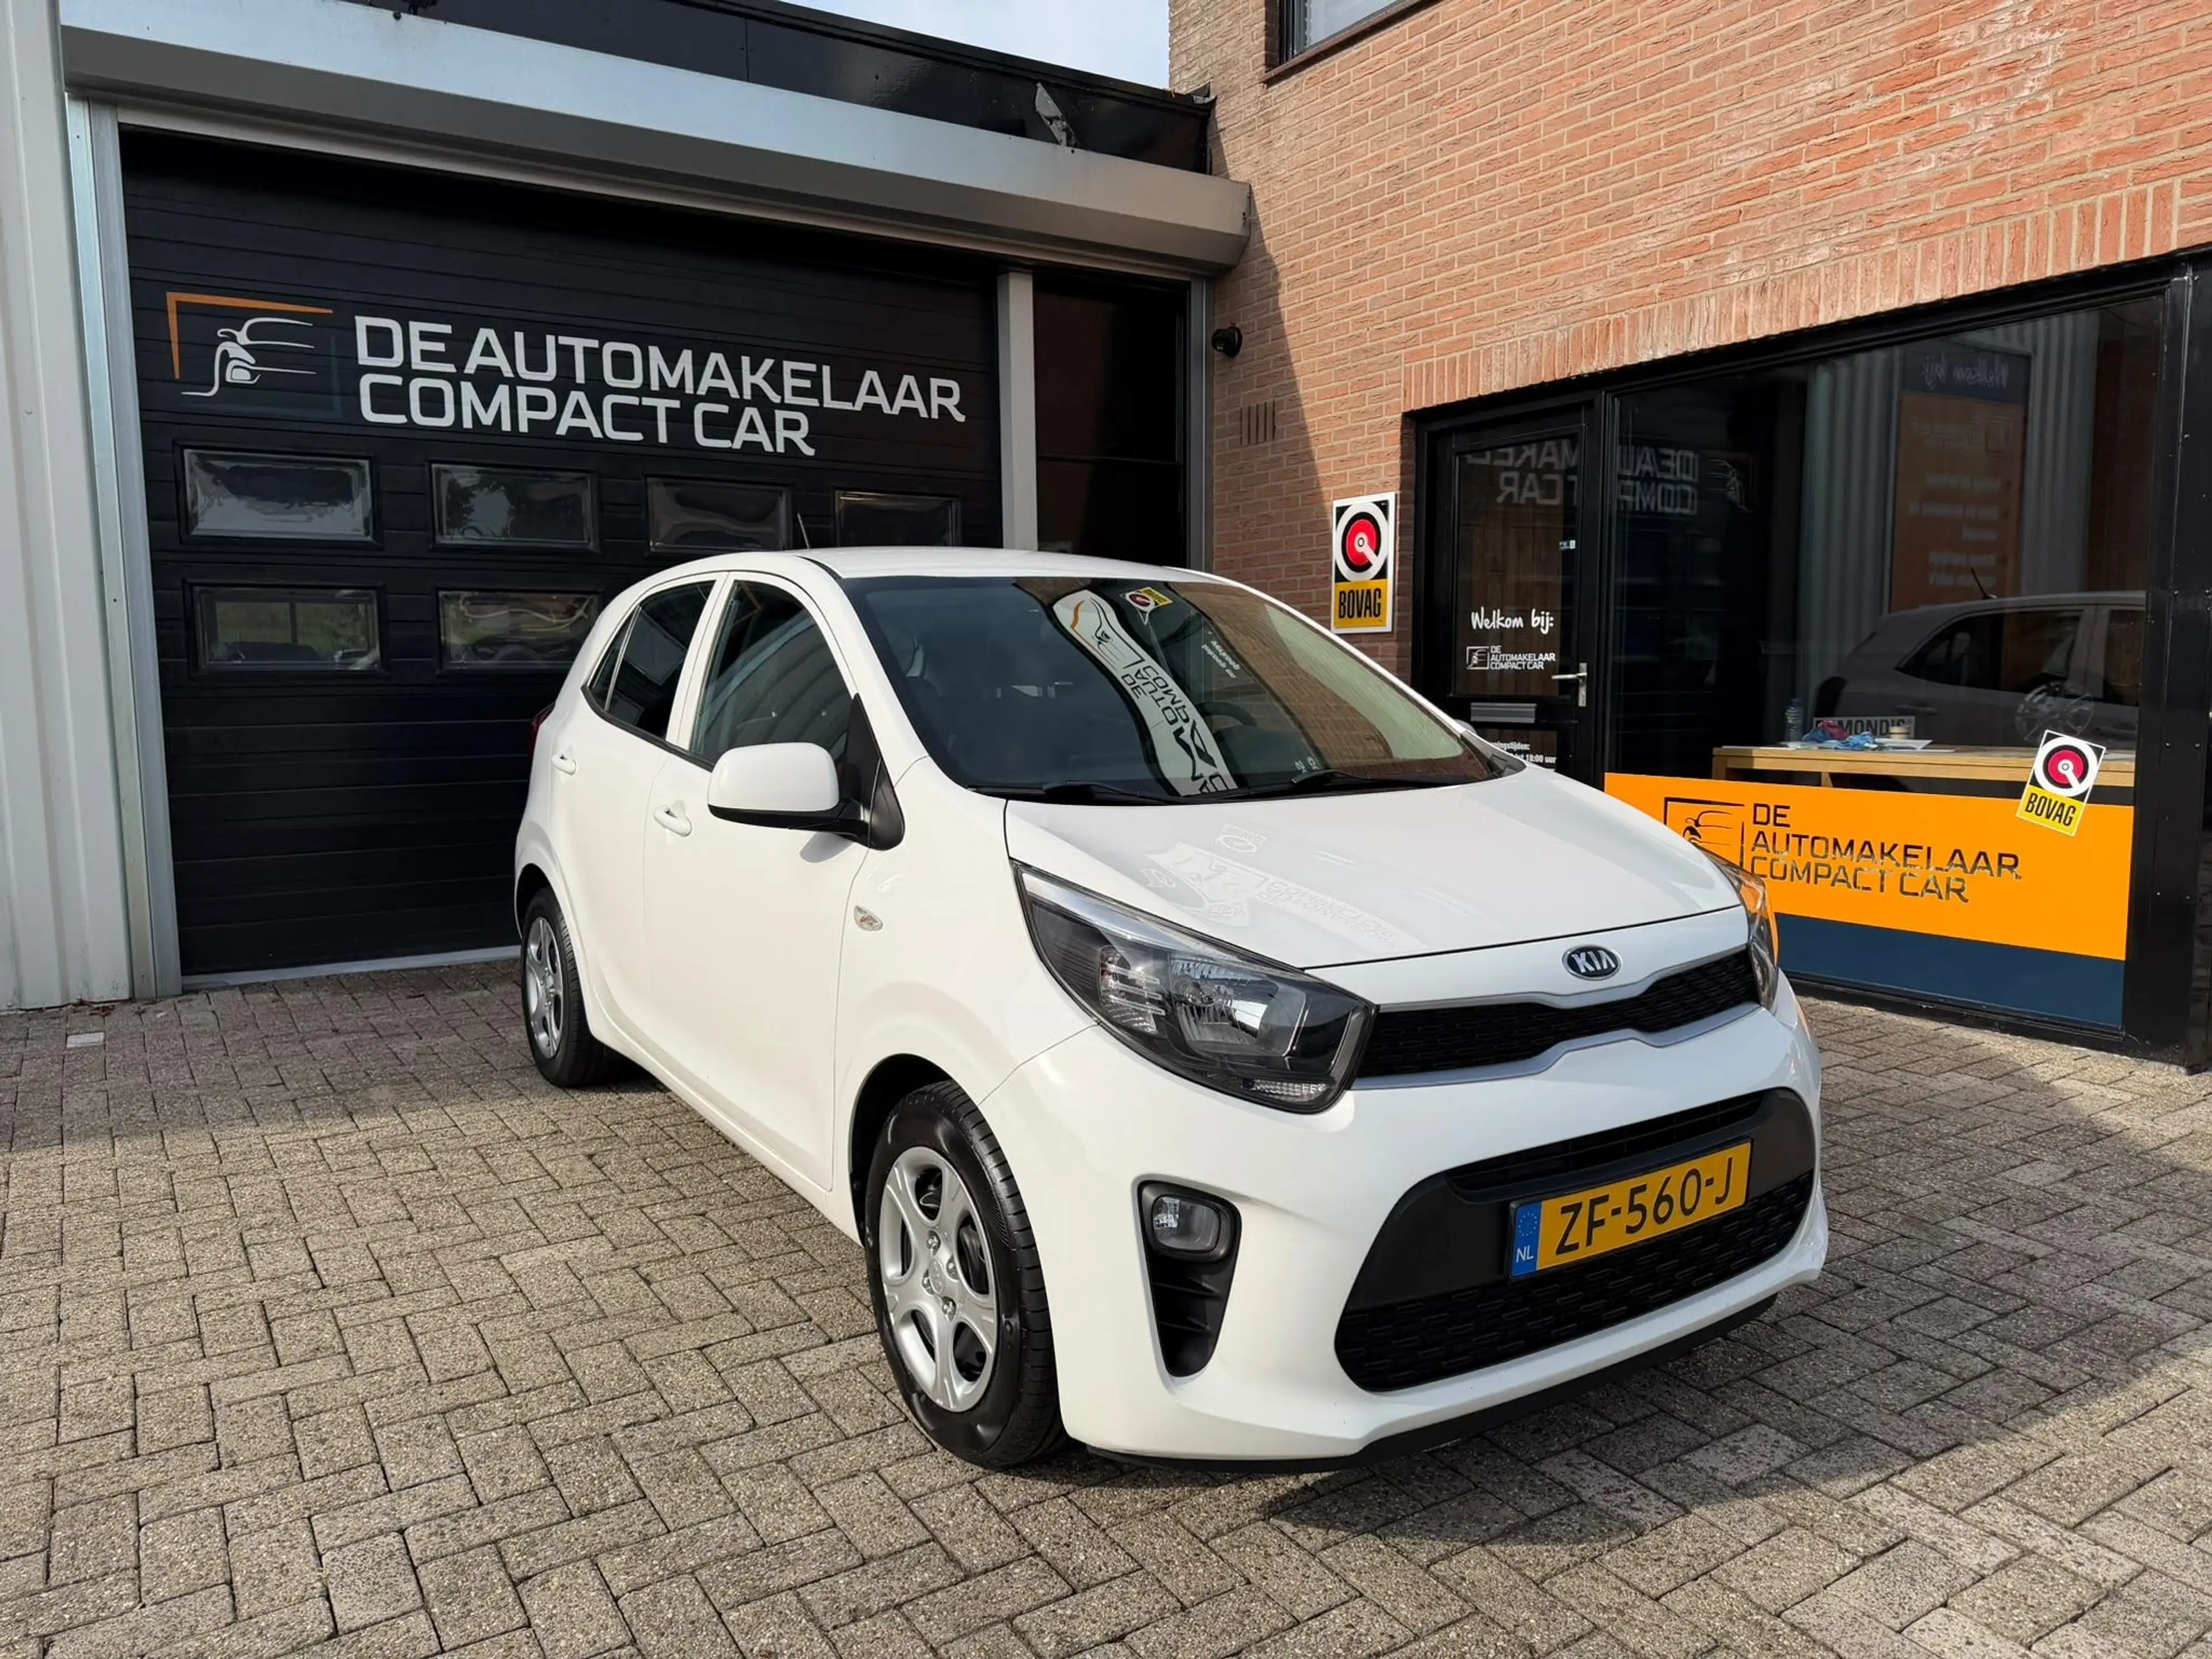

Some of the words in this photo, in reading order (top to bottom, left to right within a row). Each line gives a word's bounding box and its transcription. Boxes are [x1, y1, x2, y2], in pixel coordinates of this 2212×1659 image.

[354, 315, 457, 373] DE
[464, 328, 966, 422] AUTOMAKELAAR
[359, 373, 681, 444] COMPACT
[694, 403, 815, 456] CAR
[1339, 588, 1381, 619] BOVAG
[1471, 606, 1524, 630] Welkom
[1531, 608, 1554, 635] bij:
[1490, 645, 1502, 653] DE
[1490, 653, 1556, 662] AUTOMAKELAAR
[1490, 661, 1526, 670] COMPACT
[1527, 661, 1544, 670] CAR
[1752, 803, 1791, 828] DE
[2025, 792, 2077, 827] BOVAG
[1751, 830, 2022, 880] AUTOMAKELAAR
[1749, 855, 1892, 892] COMPACT
[1899, 872, 1969, 903] CAR
[1571, 950, 1616, 973] KIA
[1555, 1156, 1733, 1256] ZF-560-J
[1516, 1247, 1534, 1263] NL
